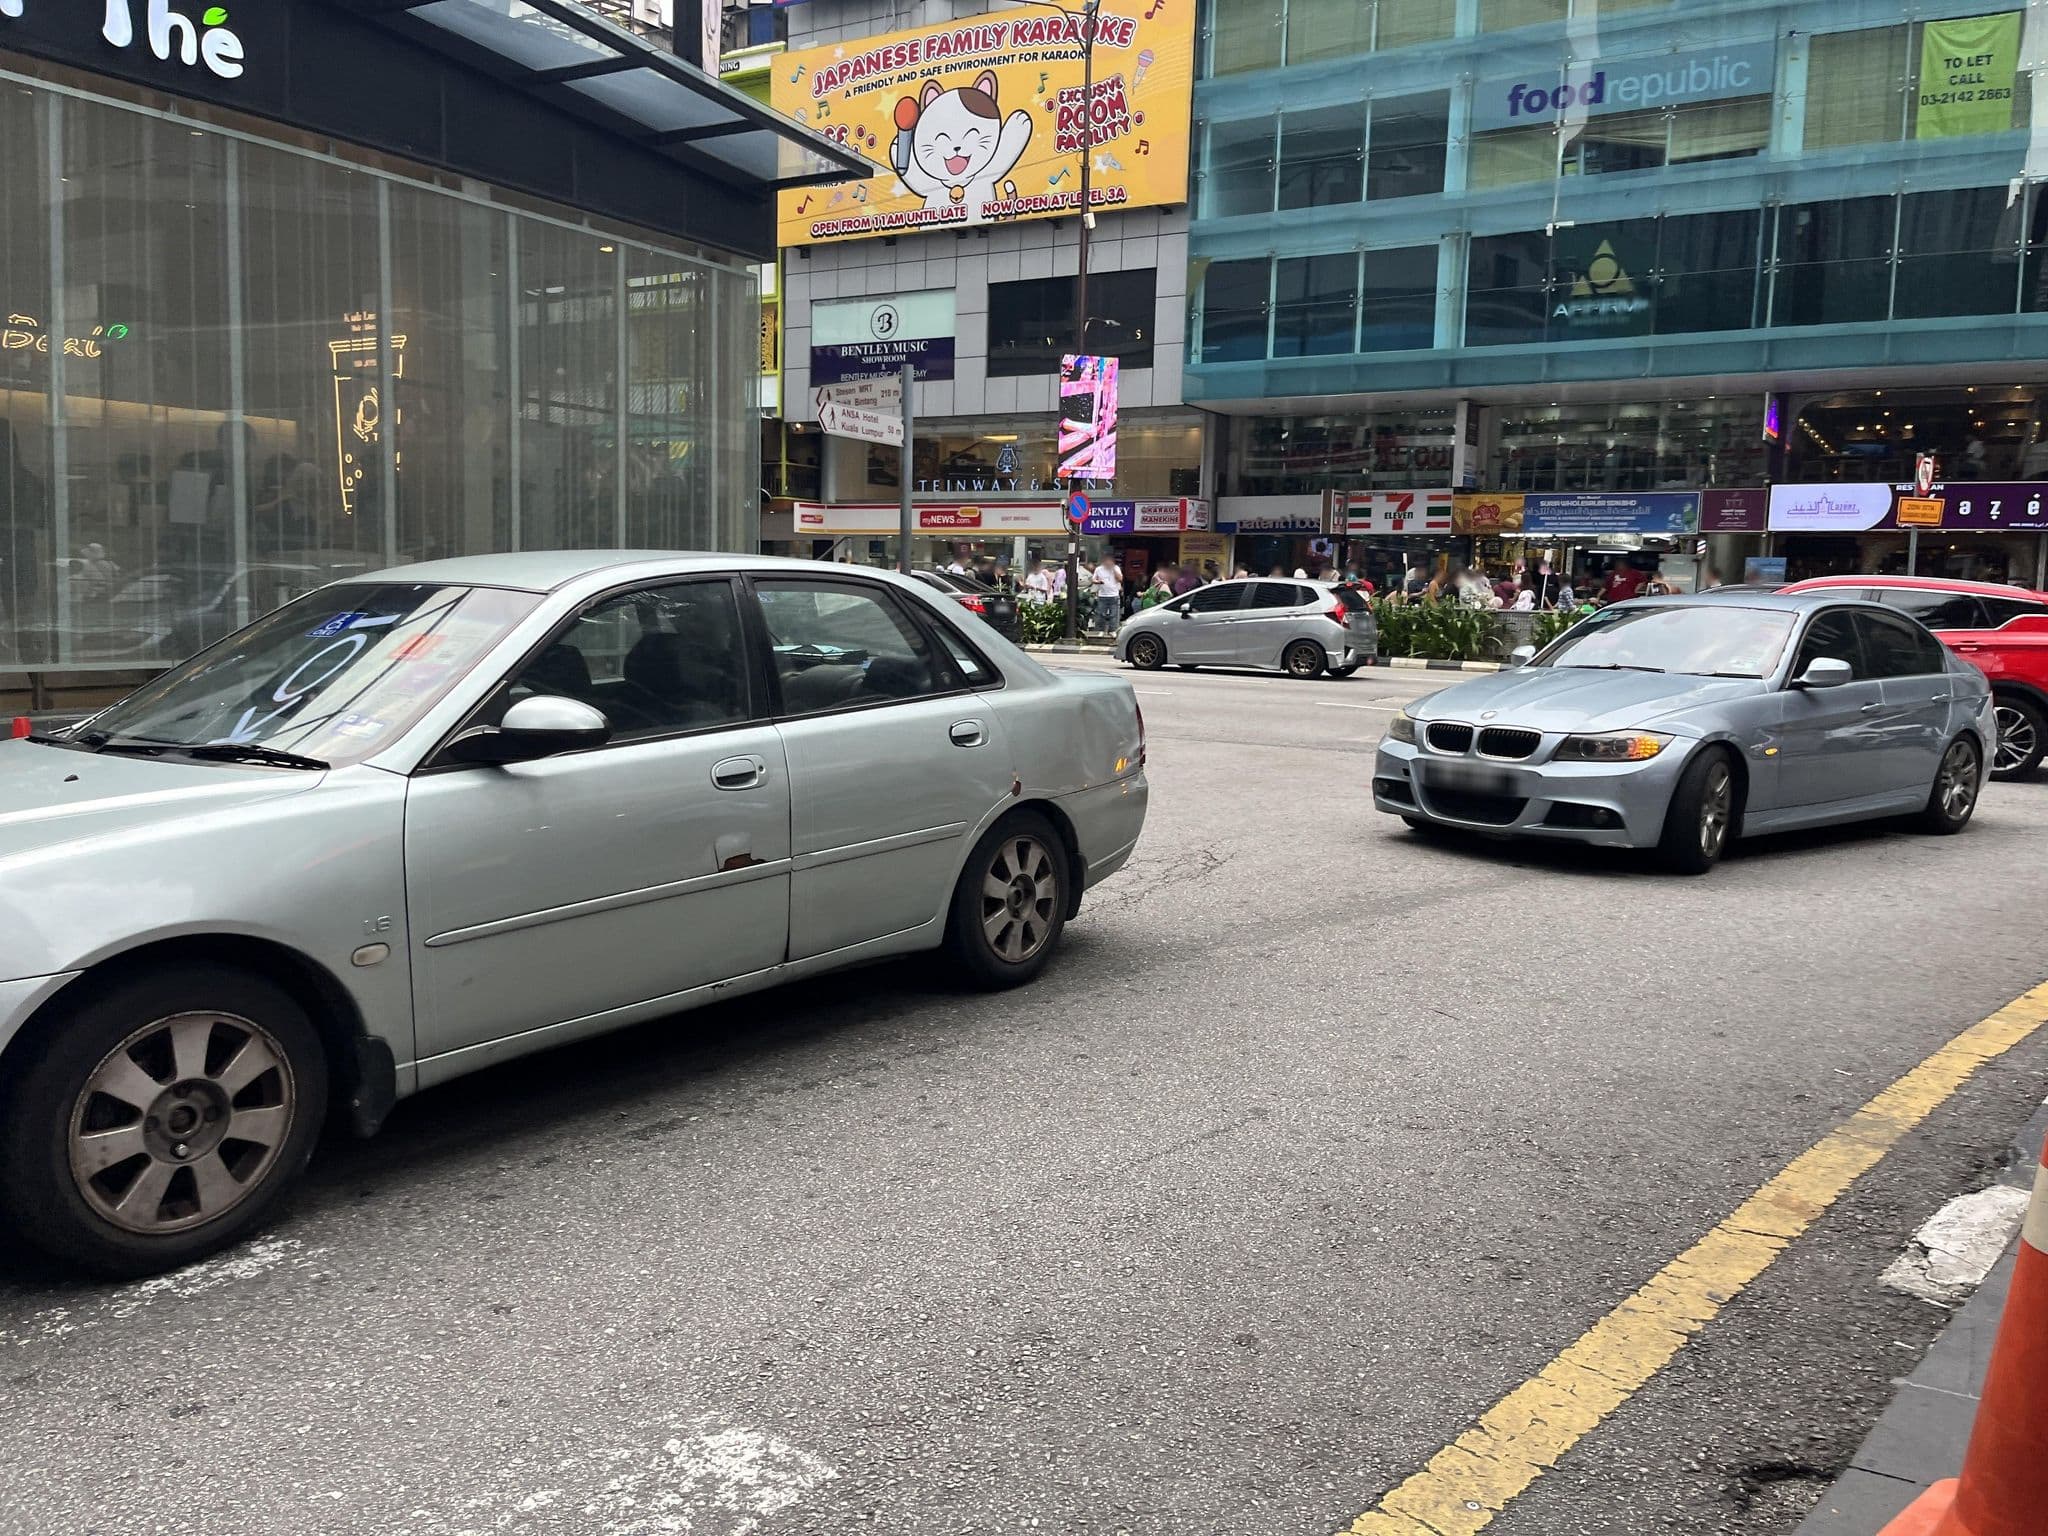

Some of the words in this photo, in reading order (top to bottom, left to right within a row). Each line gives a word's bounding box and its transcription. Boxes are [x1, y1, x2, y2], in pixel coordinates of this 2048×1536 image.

[813, 41, 920, 96] JAPANESE
[925, 23, 1008, 60] FAMILY
[1012, 16, 1136, 47] KARAOKE
[1944, 57, 1963, 69] TO
[1967, 54, 1994, 67] LET
[845, 90, 851, 98] A
[853, 76, 894, 96] FRIENDLY
[897, 72, 918, 83] AND
[920, 66, 942, 79] SAFE
[945, 54, 1016, 74] ENVIRONMENT
[1018, 53, 1038, 62] FOR
[1041, 50, 1086, 61] KARAOK
[1949, 73, 1985, 86] CALL
[1920, 91, 1973, 106] 03-2142
[1057, 91, 1127, 131] ROOM
[1055, 115, 1131, 151] FACILITY
[982, 201, 1012, 215] NOW
[1015, 196, 1048, 210] OPEN
[1050, 194, 1067, 207] AT
[1069, 189, 1104, 205] LEEL
[1107, 187, 1126, 201] 3A
[812, 222, 839, 235] OPEN
[842, 217, 871, 231] FROM
[873, 213, 904, 228] 11AM
[907, 209, 938, 224] UNTIL
[941, 205, 967, 219] LATE
[841, 343, 890, 357] BENTLEY
[893, 340, 929, 354] MUSIC
[861, 354, 906, 364] SHOWROOM
[841, 408, 860, 419] ANSA
[862, 413, 879, 424] Hotel
[917, 478, 1021, 492] TEINWAY
[1053, 477, 1114, 491] SNS
[1385, 493, 1415, 531] 7
[1091, 519, 1125, 529] MUSIC
